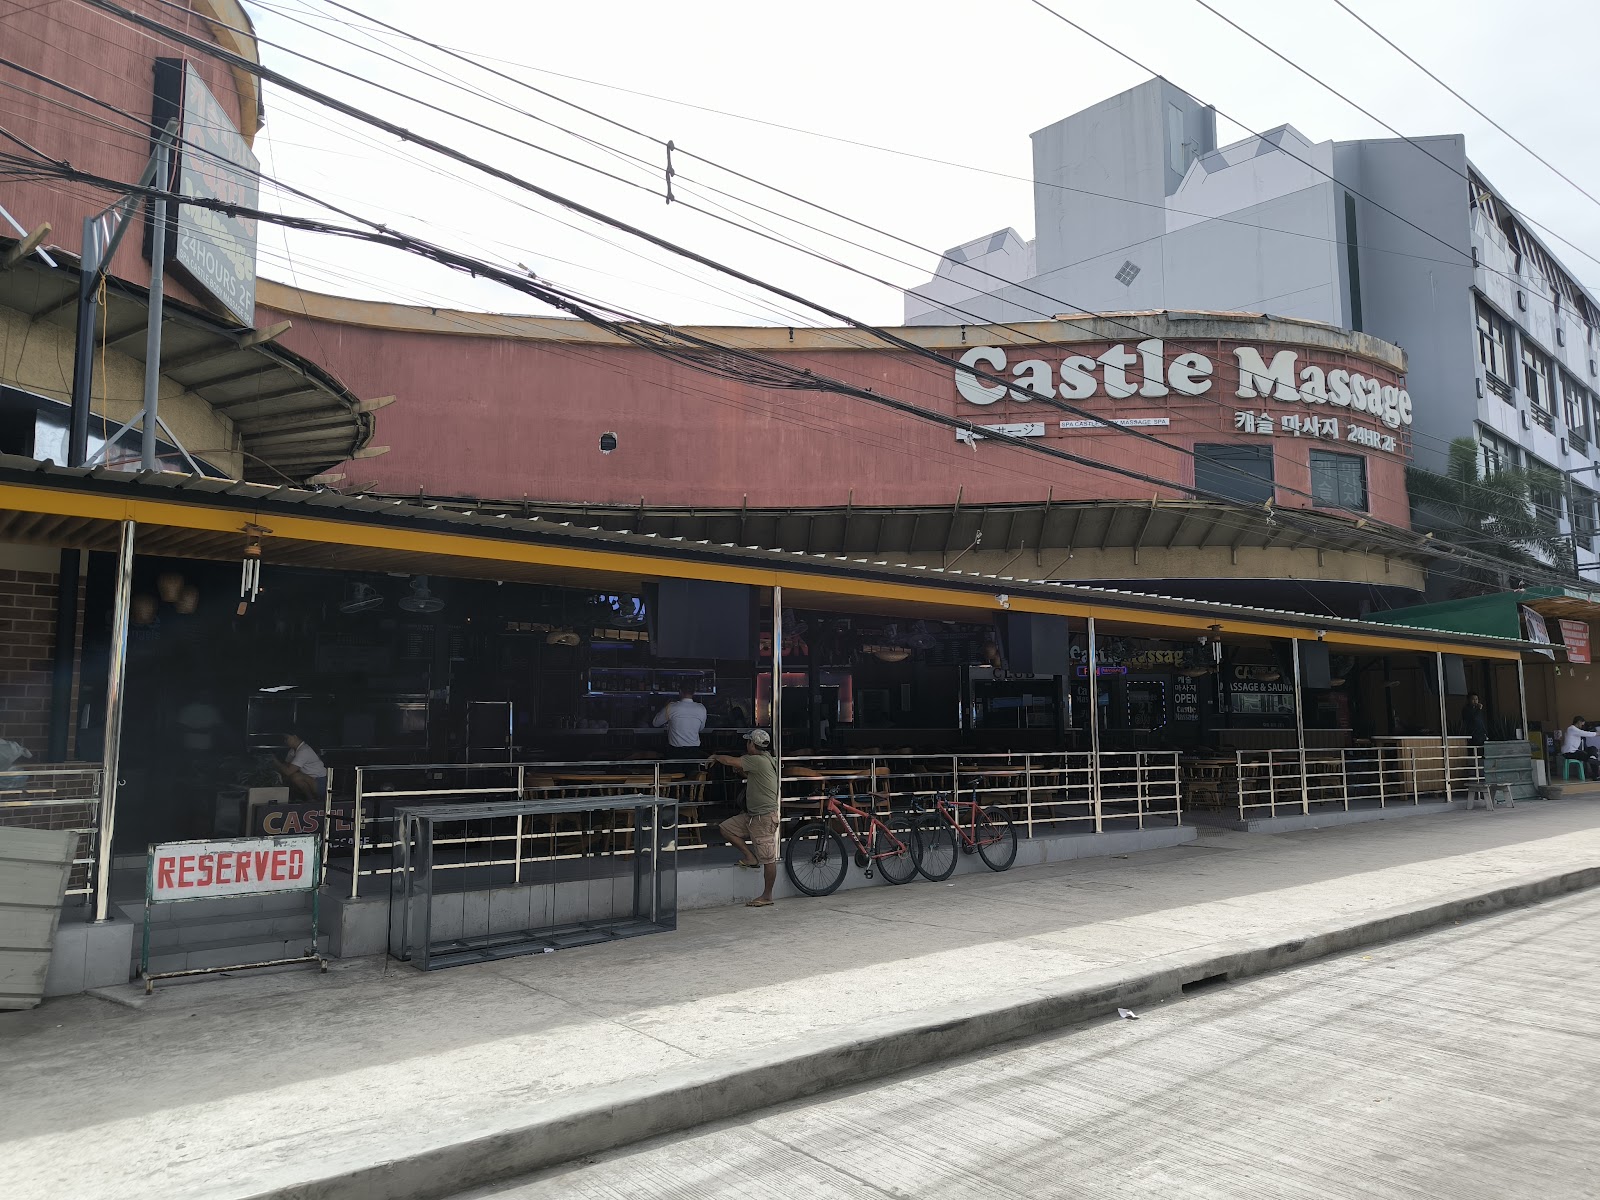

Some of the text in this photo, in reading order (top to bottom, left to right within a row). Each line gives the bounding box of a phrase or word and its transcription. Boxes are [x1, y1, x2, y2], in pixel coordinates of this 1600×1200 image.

[187, 122, 256, 237] Castle
[182, 176, 254, 281] Massage
[179, 248, 190, 265] SPA
[190, 259, 210, 284] CASTLE
[223, 292, 244, 317] MASSAGE
[181, 228, 252, 310] 24HOURS 2F
[955, 338, 1413, 429] Castle Massage
[1074, 420, 1101, 428] CASTLE
[1234, 410, 1275, 434] 캐슬
[1281, 414, 1339, 439] 마사지
[1174, 684, 1197, 693] 마사지
[1174, 693, 1198, 704] OPEN
[1267, 683, 1294, 692] SAUNA
[157, 849, 304, 889] RESERVED
